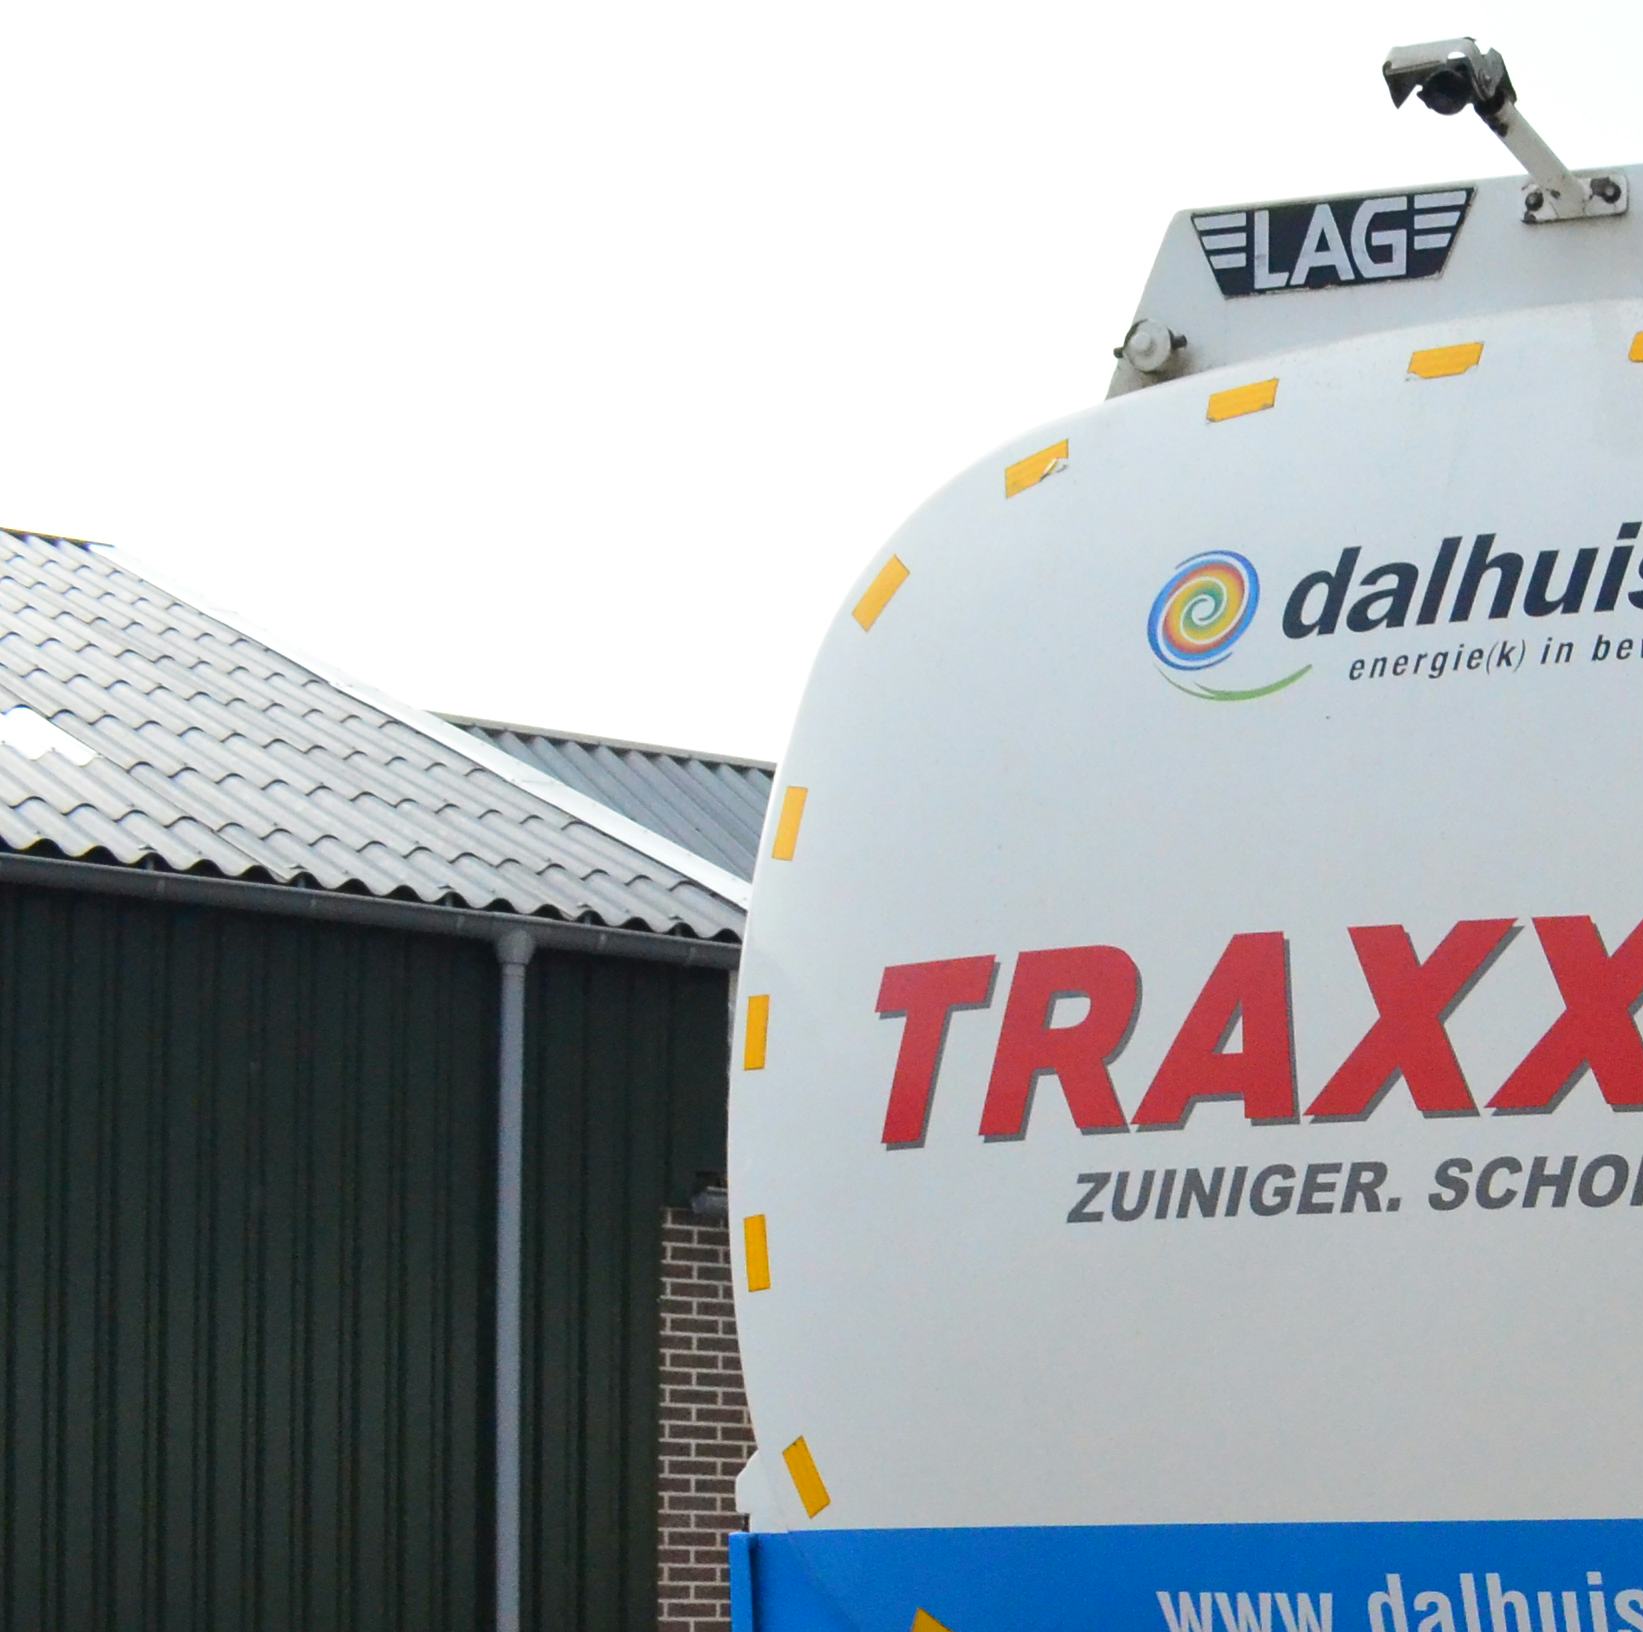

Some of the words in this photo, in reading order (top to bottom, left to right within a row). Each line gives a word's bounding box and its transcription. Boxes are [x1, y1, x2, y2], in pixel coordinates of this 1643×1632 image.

[1253, 195, 1408, 290] LAG
[1348, 638, 1527, 682] energie(k)
[1540, 636, 1573, 665] in
[1066, 1162, 1402, 1224] ZUINIGER.
